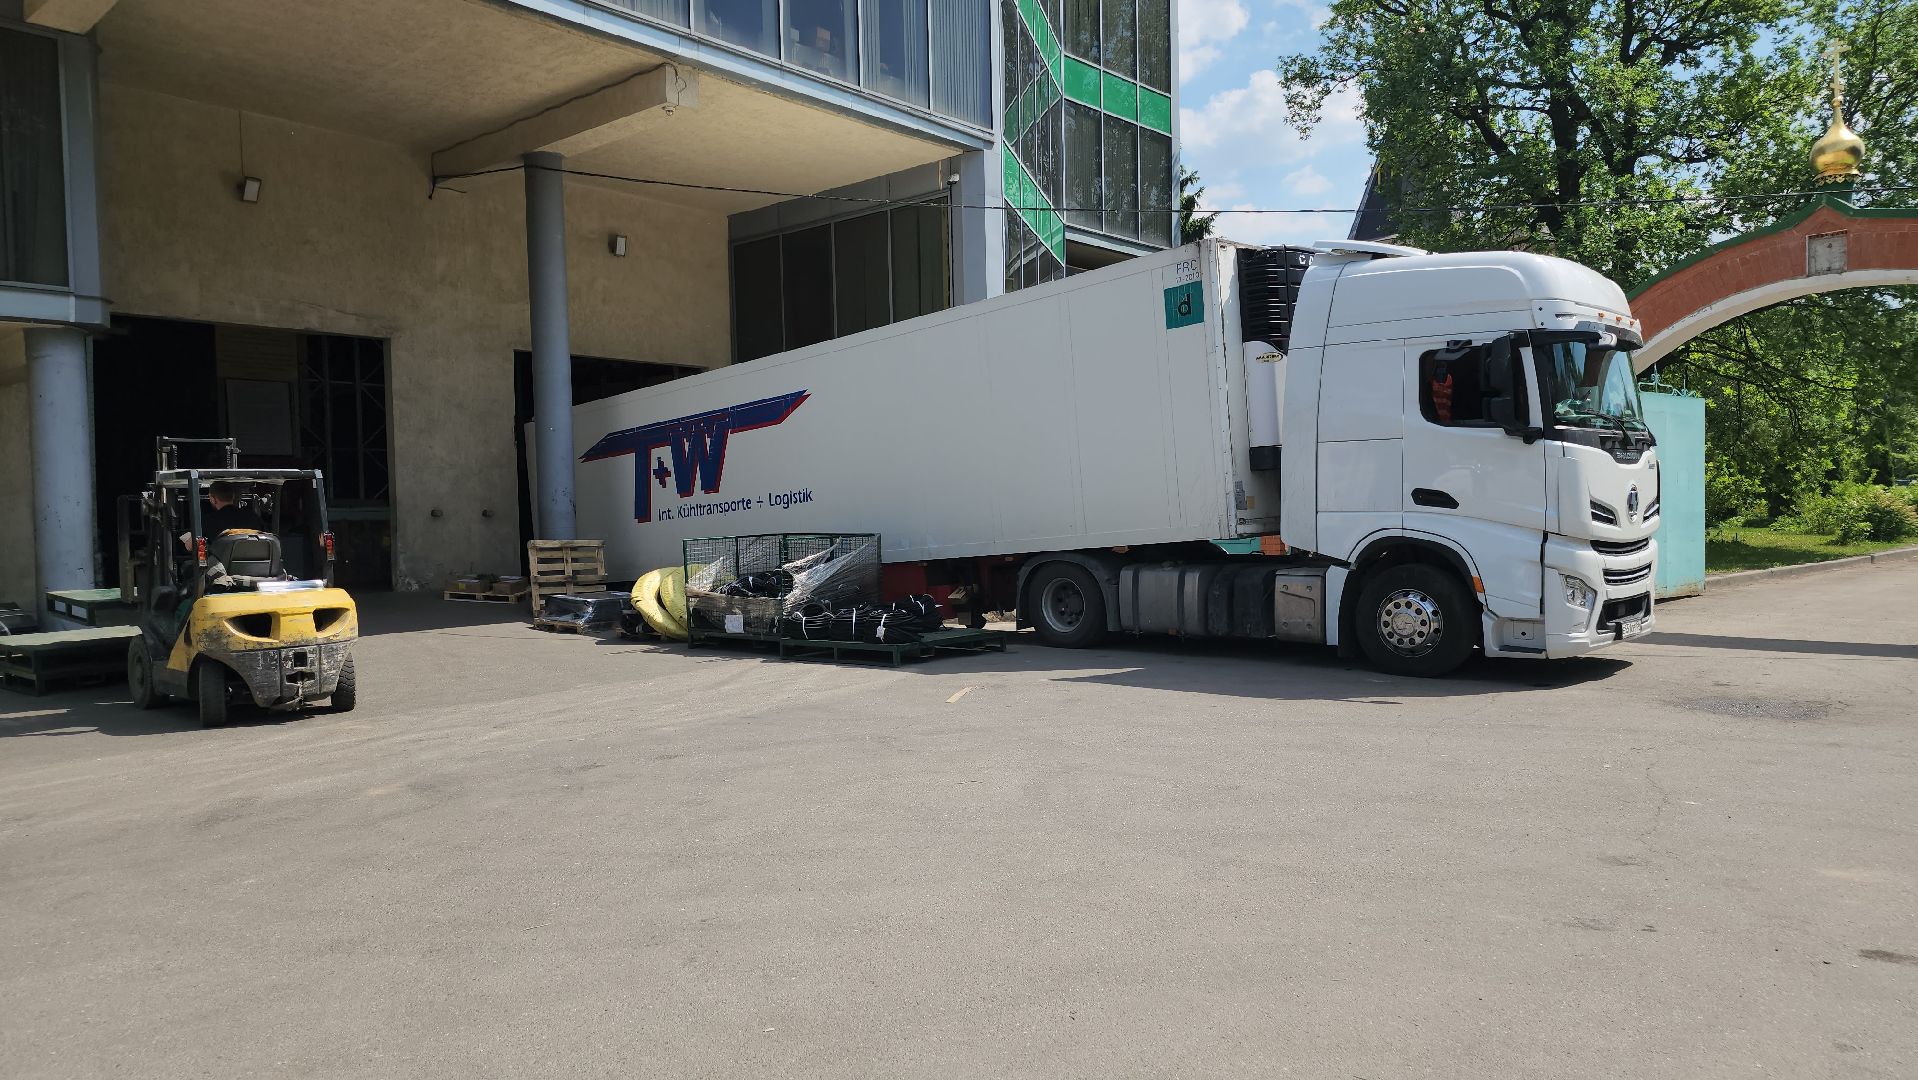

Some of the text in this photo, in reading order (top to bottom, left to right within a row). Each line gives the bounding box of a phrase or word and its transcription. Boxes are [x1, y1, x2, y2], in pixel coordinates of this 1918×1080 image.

[1176, 259, 1198, 275] FRC
[658, 507, 674, 522] Int.
[676, 497, 752, 519] Kühltransporte
[768, 488, 814, 510] Logistik
